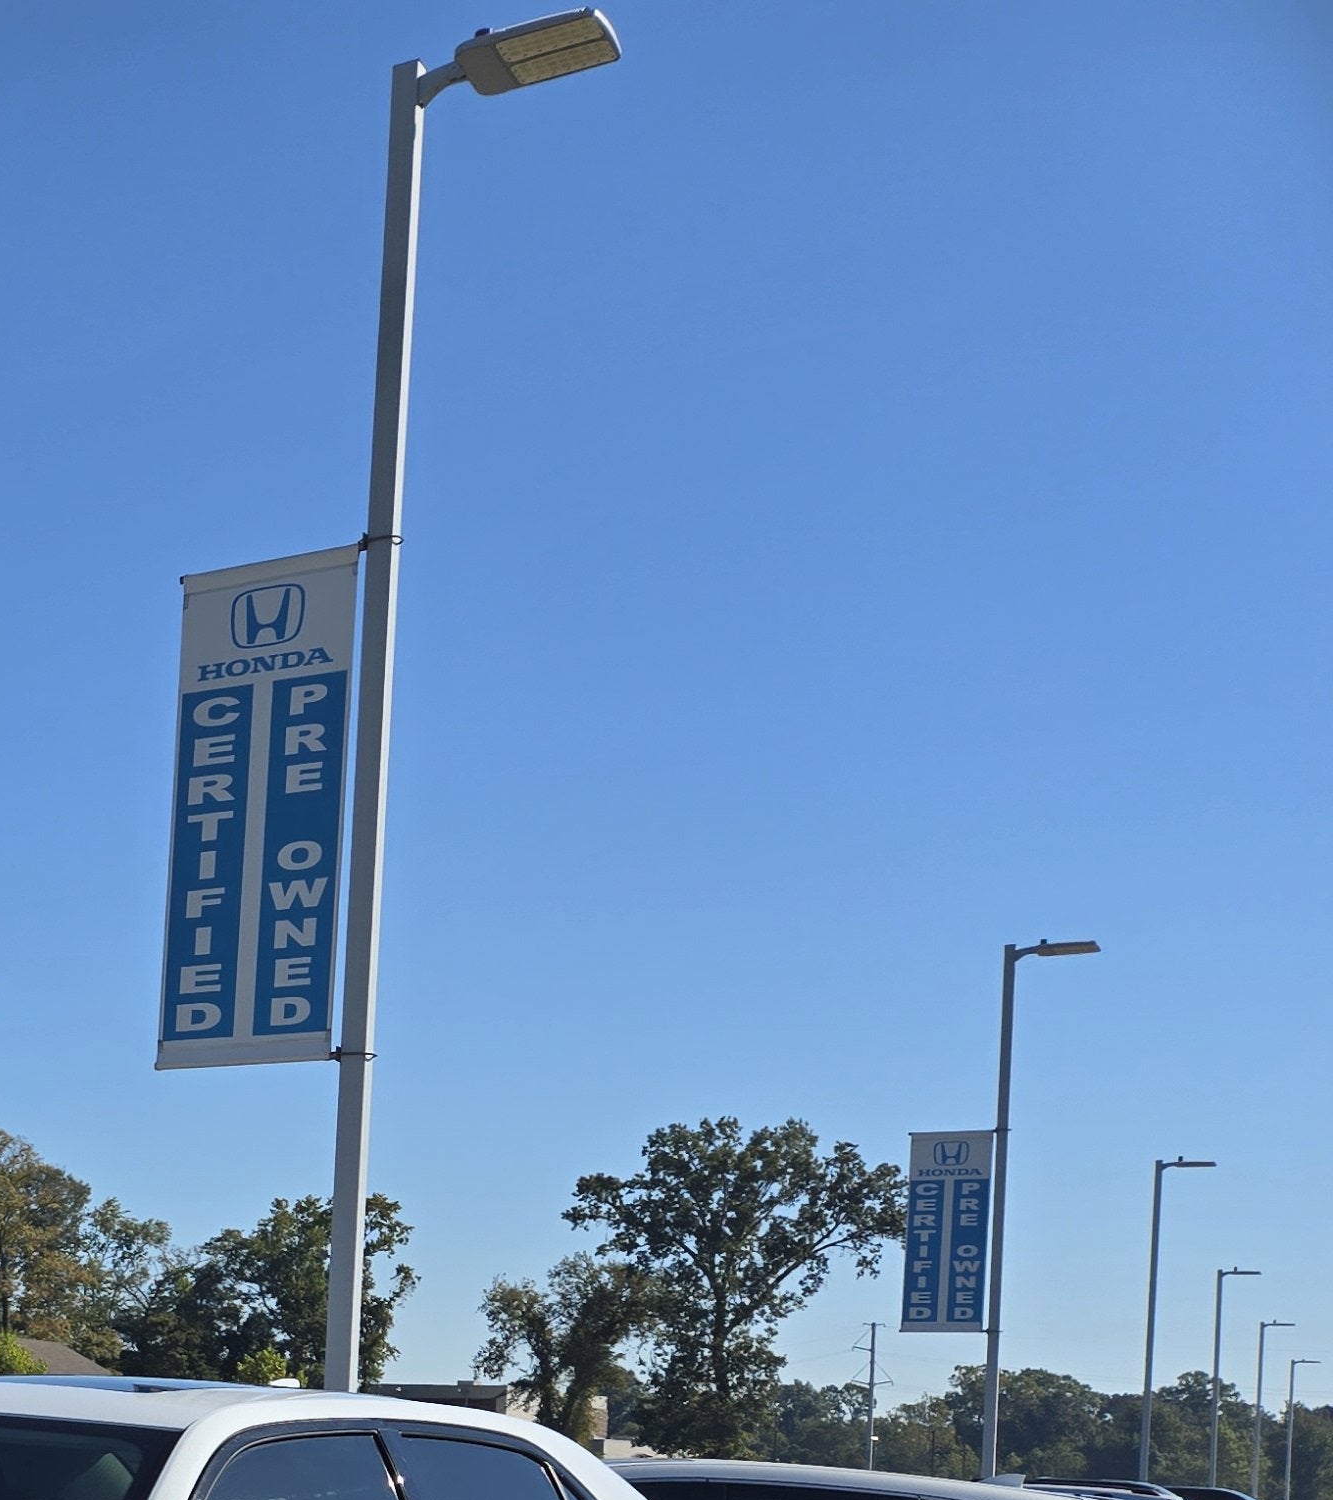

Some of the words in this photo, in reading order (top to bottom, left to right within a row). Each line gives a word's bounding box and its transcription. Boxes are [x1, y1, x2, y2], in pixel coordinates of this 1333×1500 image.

[197, 647, 334, 682] HONDA
[284, 683, 328, 794] PRE
[174, 695, 241, 1034] CERTIFIED
[268, 840, 328, 1027] OWNED
[917, 1168, 982, 1177] HONDA
[959, 1182, 981, 1226] PRE
[908, 1183, 940, 1320] CERTIFIED
[952, 1244, 982, 1320] OWNED
